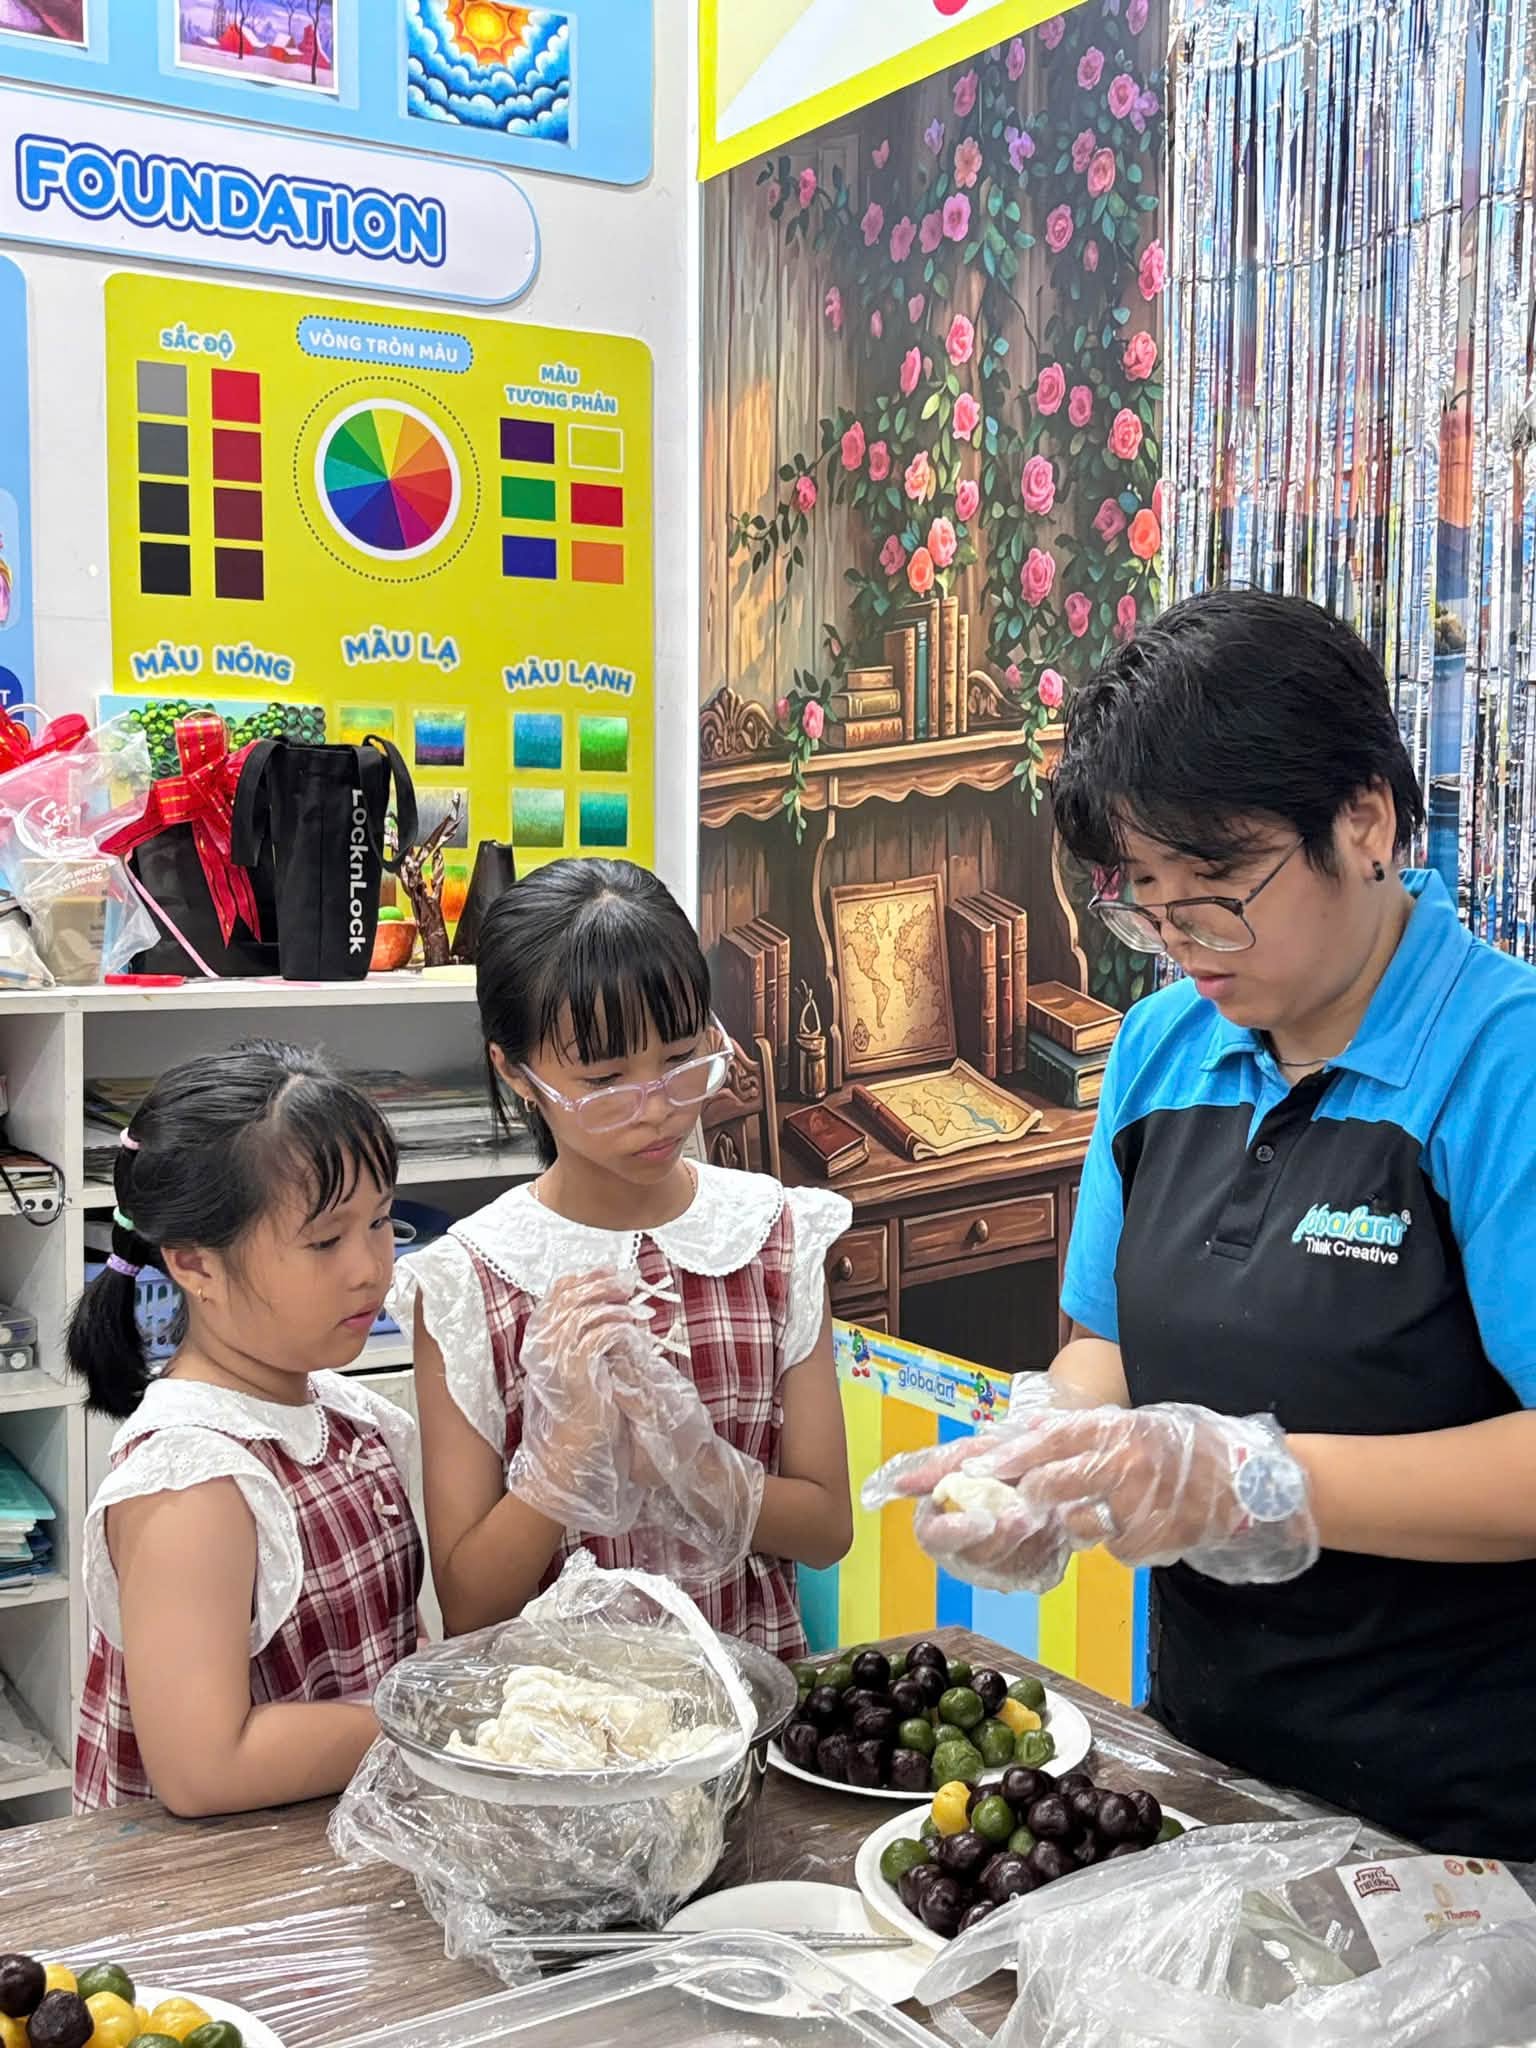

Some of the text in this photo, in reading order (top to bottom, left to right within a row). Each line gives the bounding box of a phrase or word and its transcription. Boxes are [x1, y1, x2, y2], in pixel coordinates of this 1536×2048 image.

[18, 137, 444, 264] FOUNDATION
[161, 323, 234, 359] SẮC ĐỘ
[308, 328, 458, 363] VÒNG TRÒN MÀU
[540, 362, 579, 385] MÀU
[505, 386, 568, 408] TƯƠNG
[133, 643, 292, 682] MÀU NÓNG
[344, 627, 458, 669] MÀU LẠ
[503, 657, 633, 695] MÀU LẠNH
[1332, 1240, 1399, 1265] Creative
